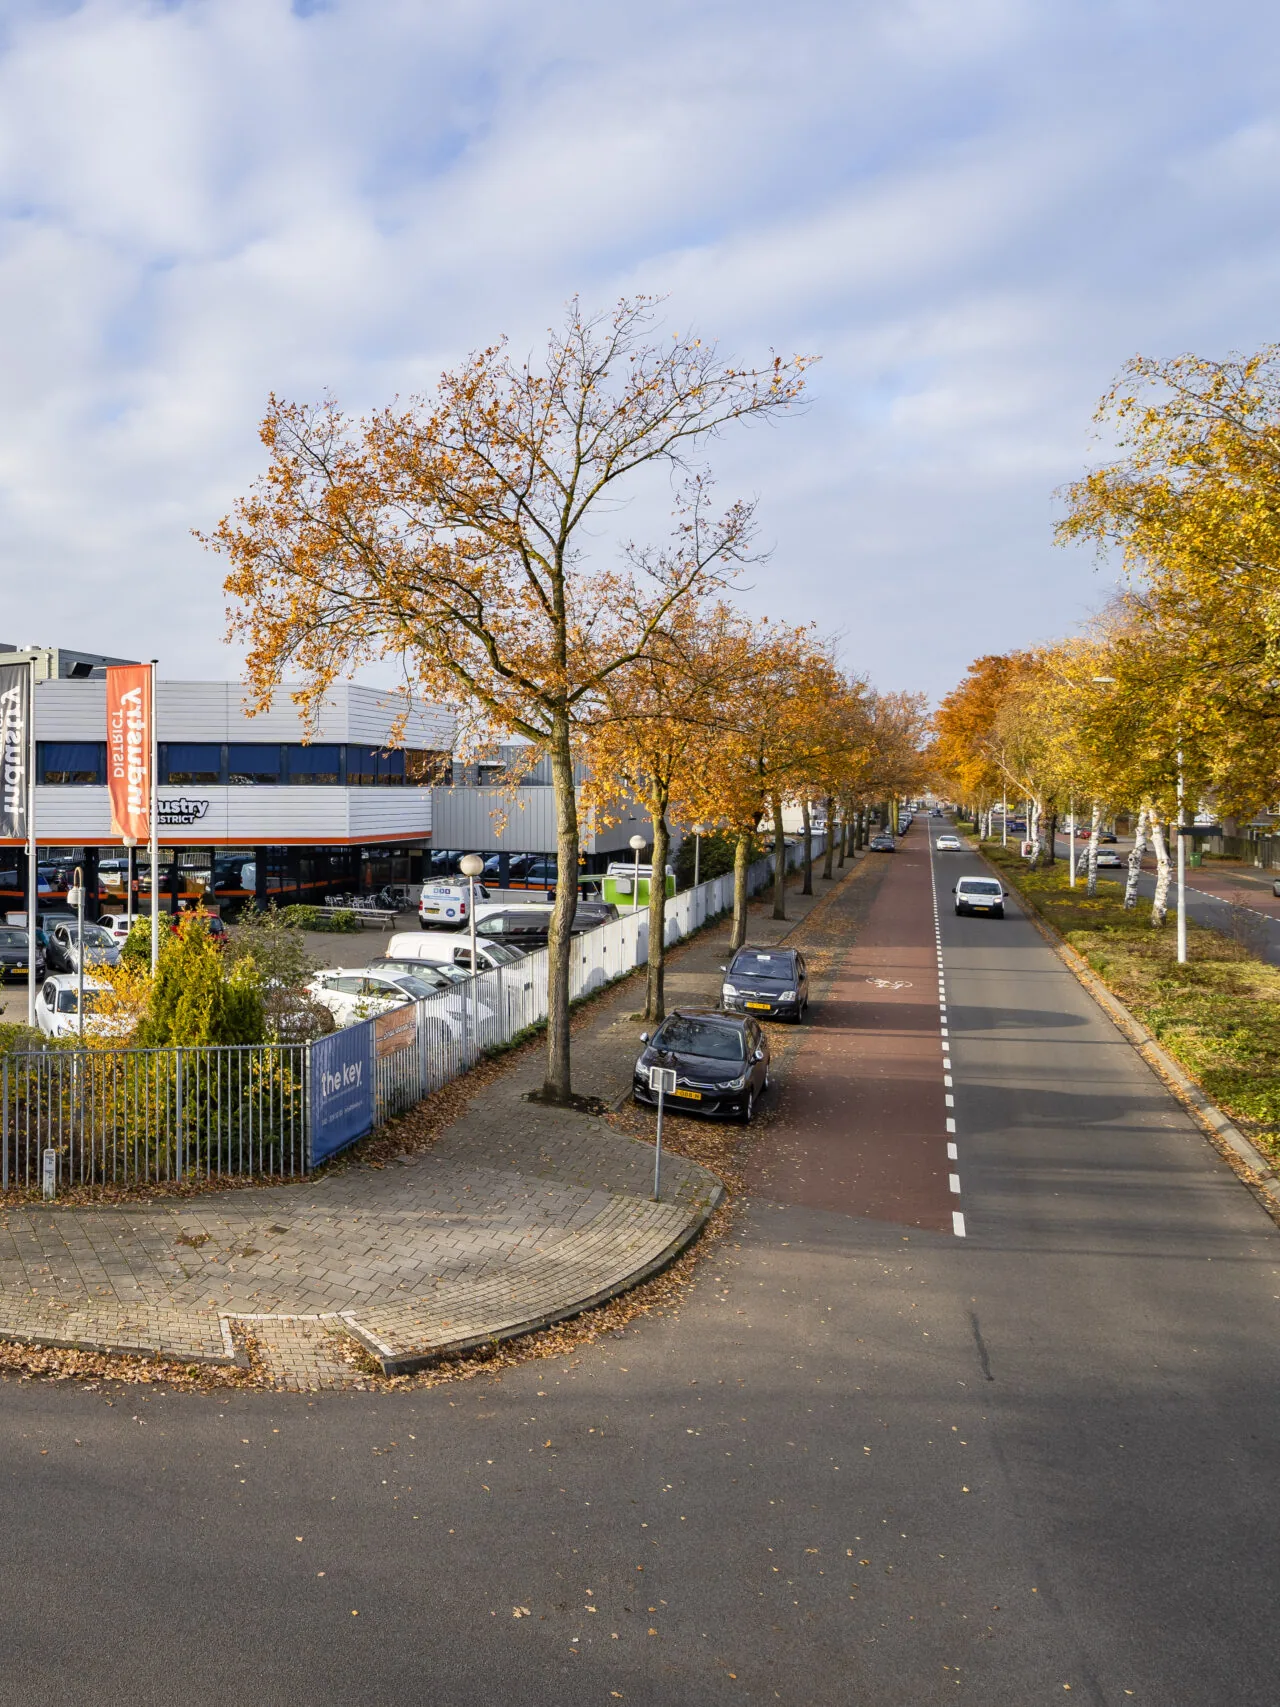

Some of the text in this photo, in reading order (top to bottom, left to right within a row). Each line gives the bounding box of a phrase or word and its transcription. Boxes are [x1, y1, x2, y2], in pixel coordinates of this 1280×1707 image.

[158, 799, 208, 817] ustry
[157, 815, 195, 823] ISTRICT
[321, 1070, 341, 1096] the
[343, 1060, 362, 1087] key.
